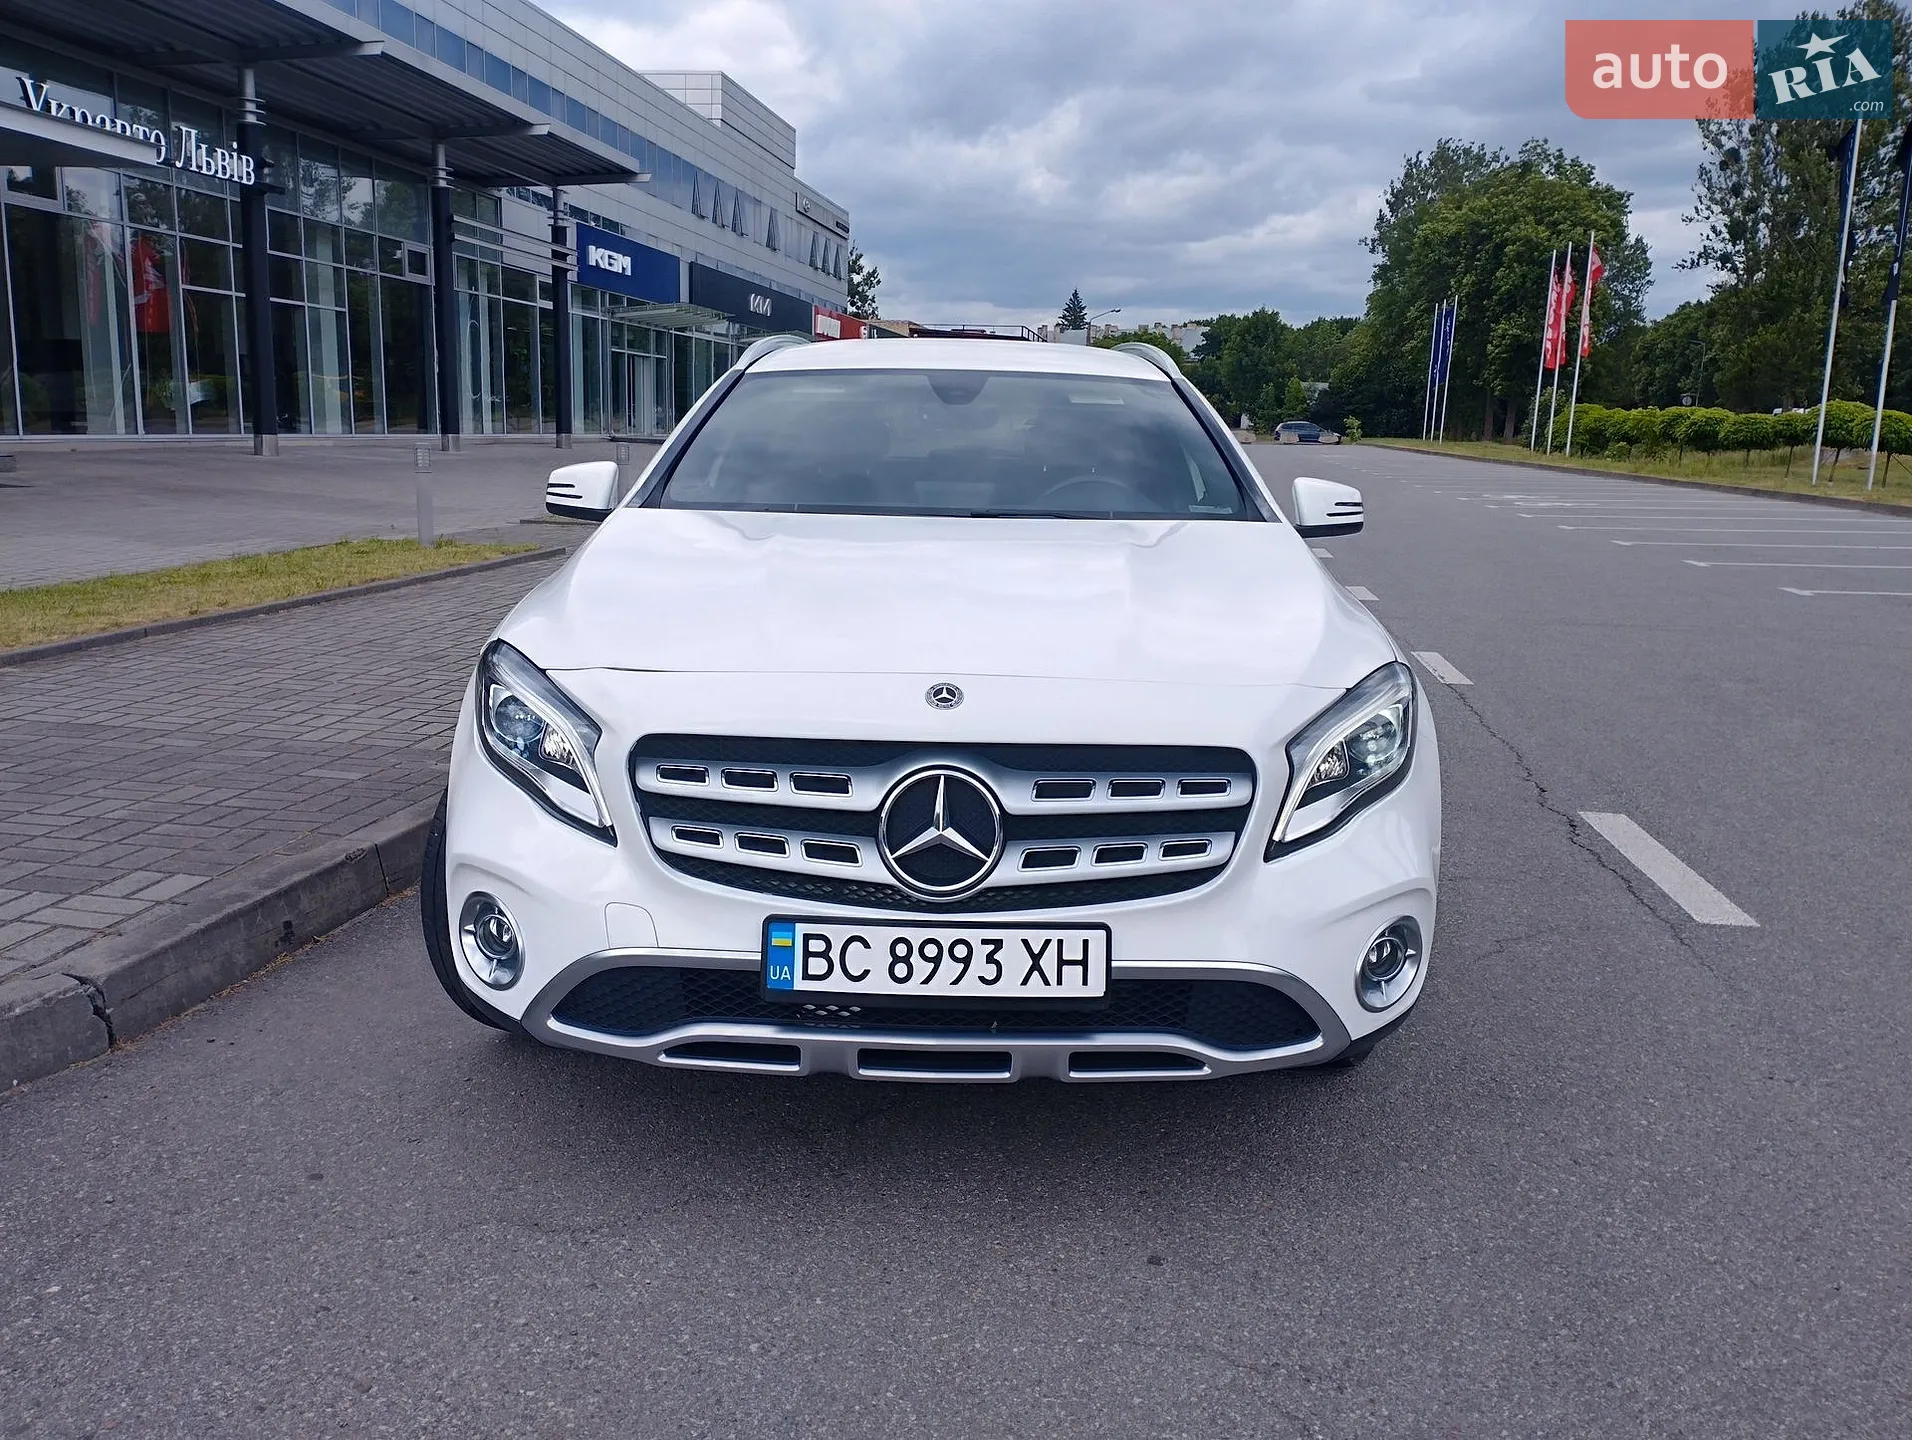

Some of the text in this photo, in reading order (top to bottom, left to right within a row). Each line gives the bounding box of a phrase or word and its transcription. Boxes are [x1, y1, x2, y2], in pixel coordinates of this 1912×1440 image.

[175, 125, 256, 186] Львів
[588, 245, 632, 277] KGM
[770, 965, 791, 981] UA
[802, 932, 1089, 987] BC 8993 XH
